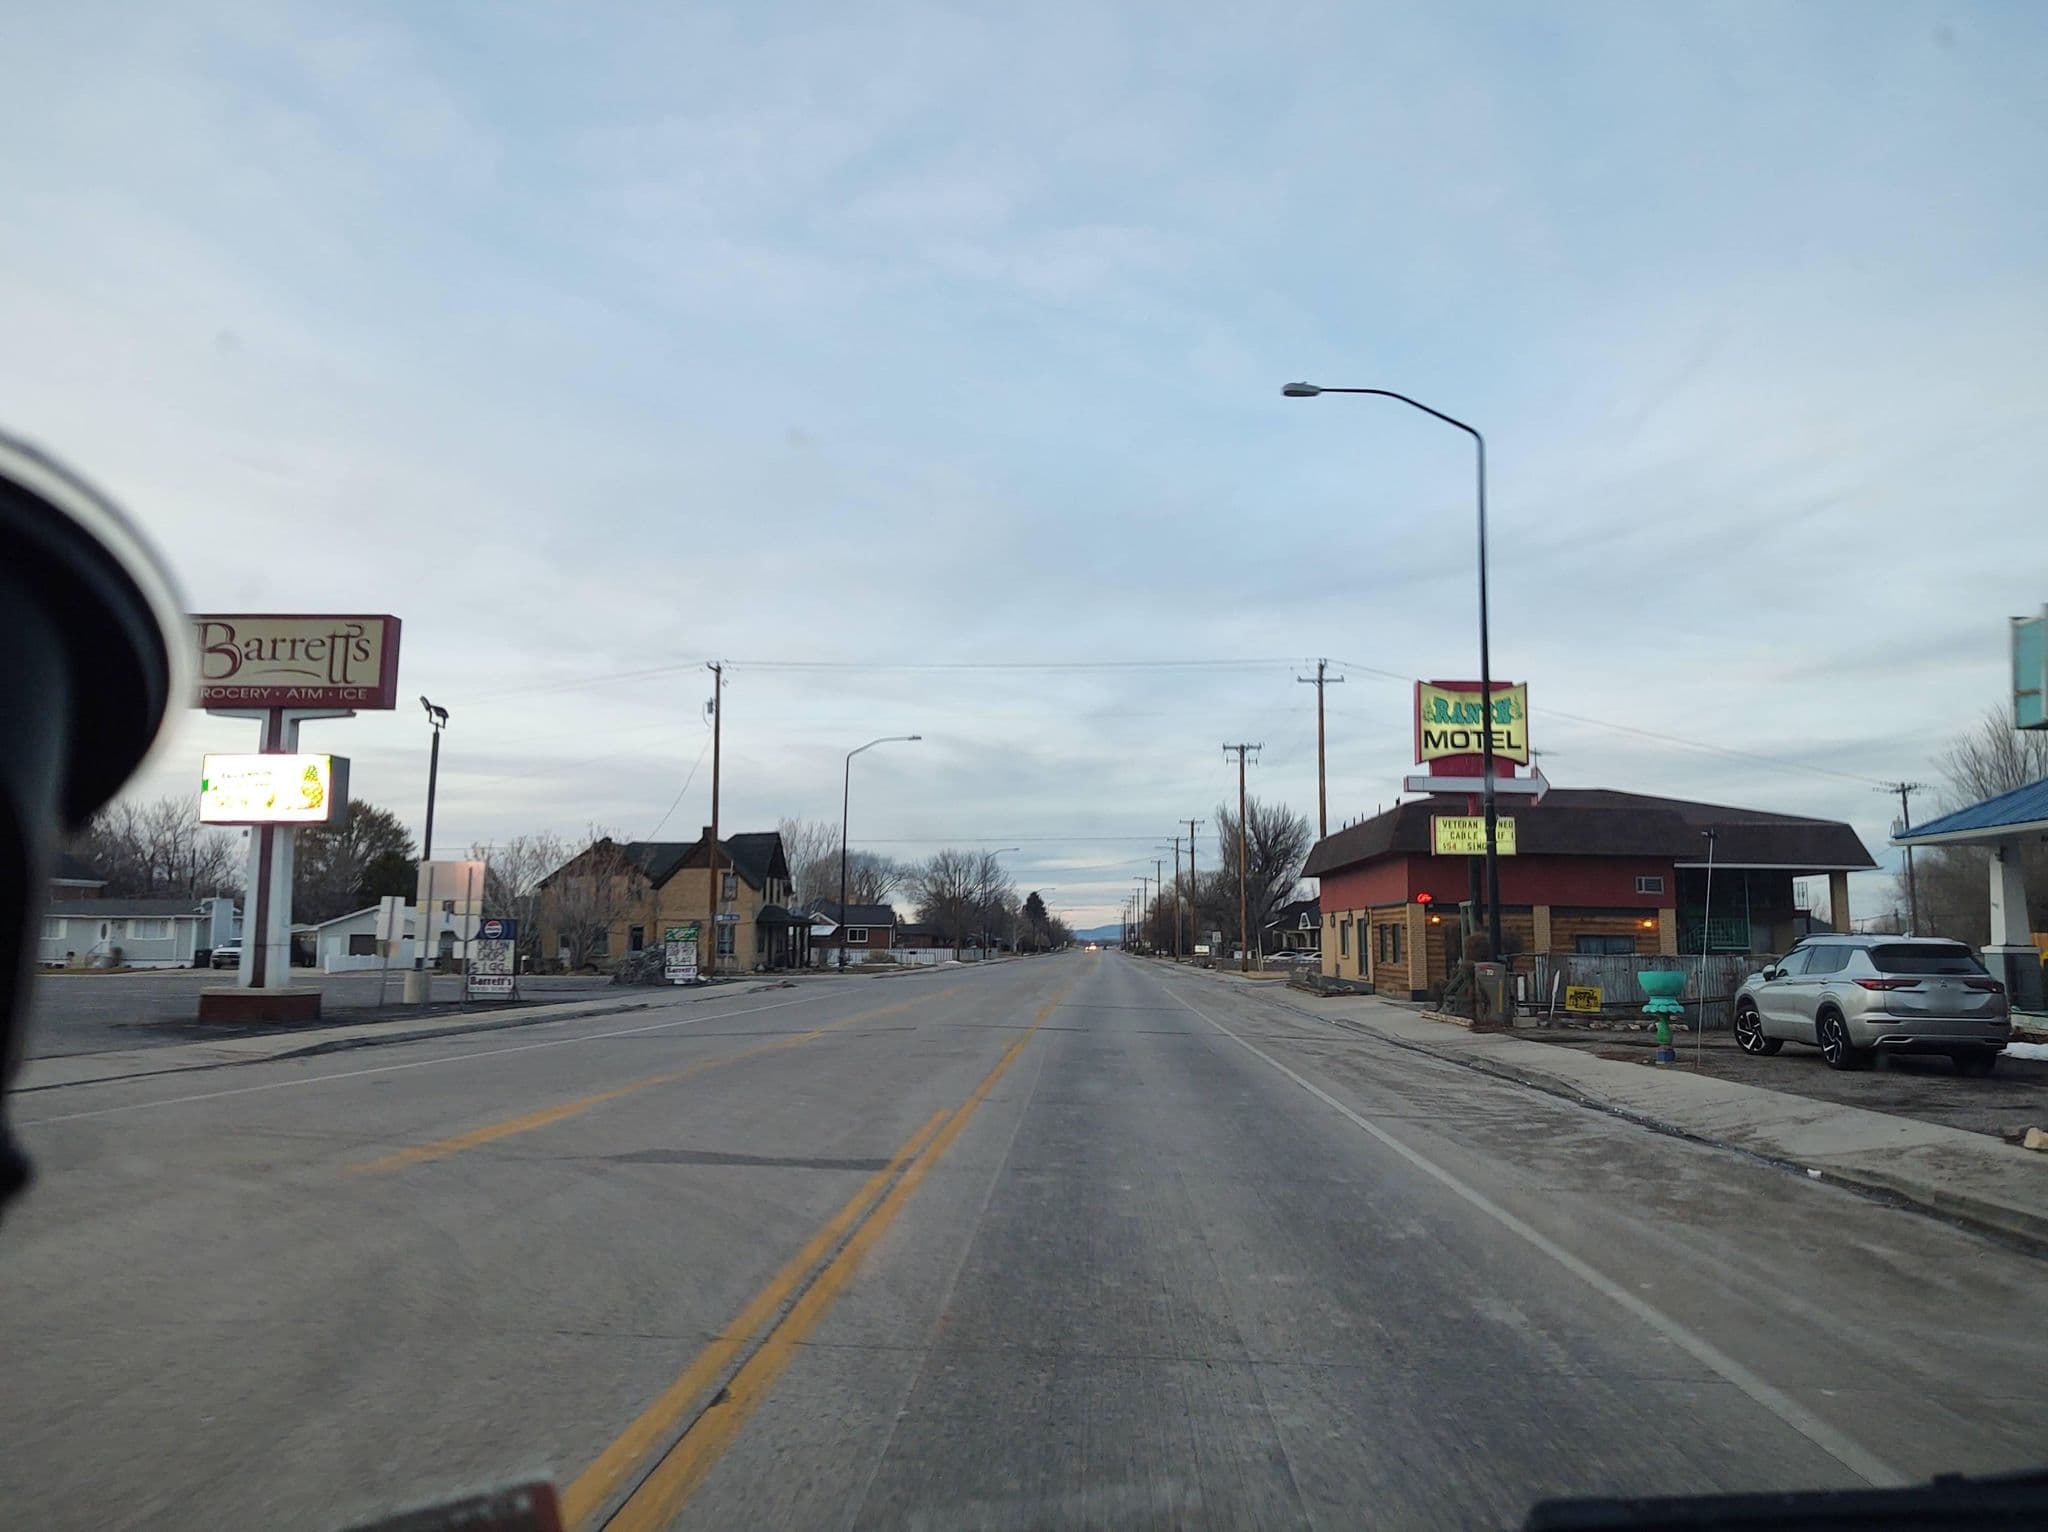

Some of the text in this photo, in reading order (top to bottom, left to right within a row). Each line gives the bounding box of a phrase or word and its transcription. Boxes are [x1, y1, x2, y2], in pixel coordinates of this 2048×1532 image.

[196, 622, 370, 684] Barrett's
[200, 687, 368, 699] ROCERY ATM ICE
[1424, 729, 1522, 750] MOTEL
[1442, 820, 1514, 829] VETERAN NED
[1450, 831, 1478, 840] CABLE
[469, 976, 512, 986] Barrett's
